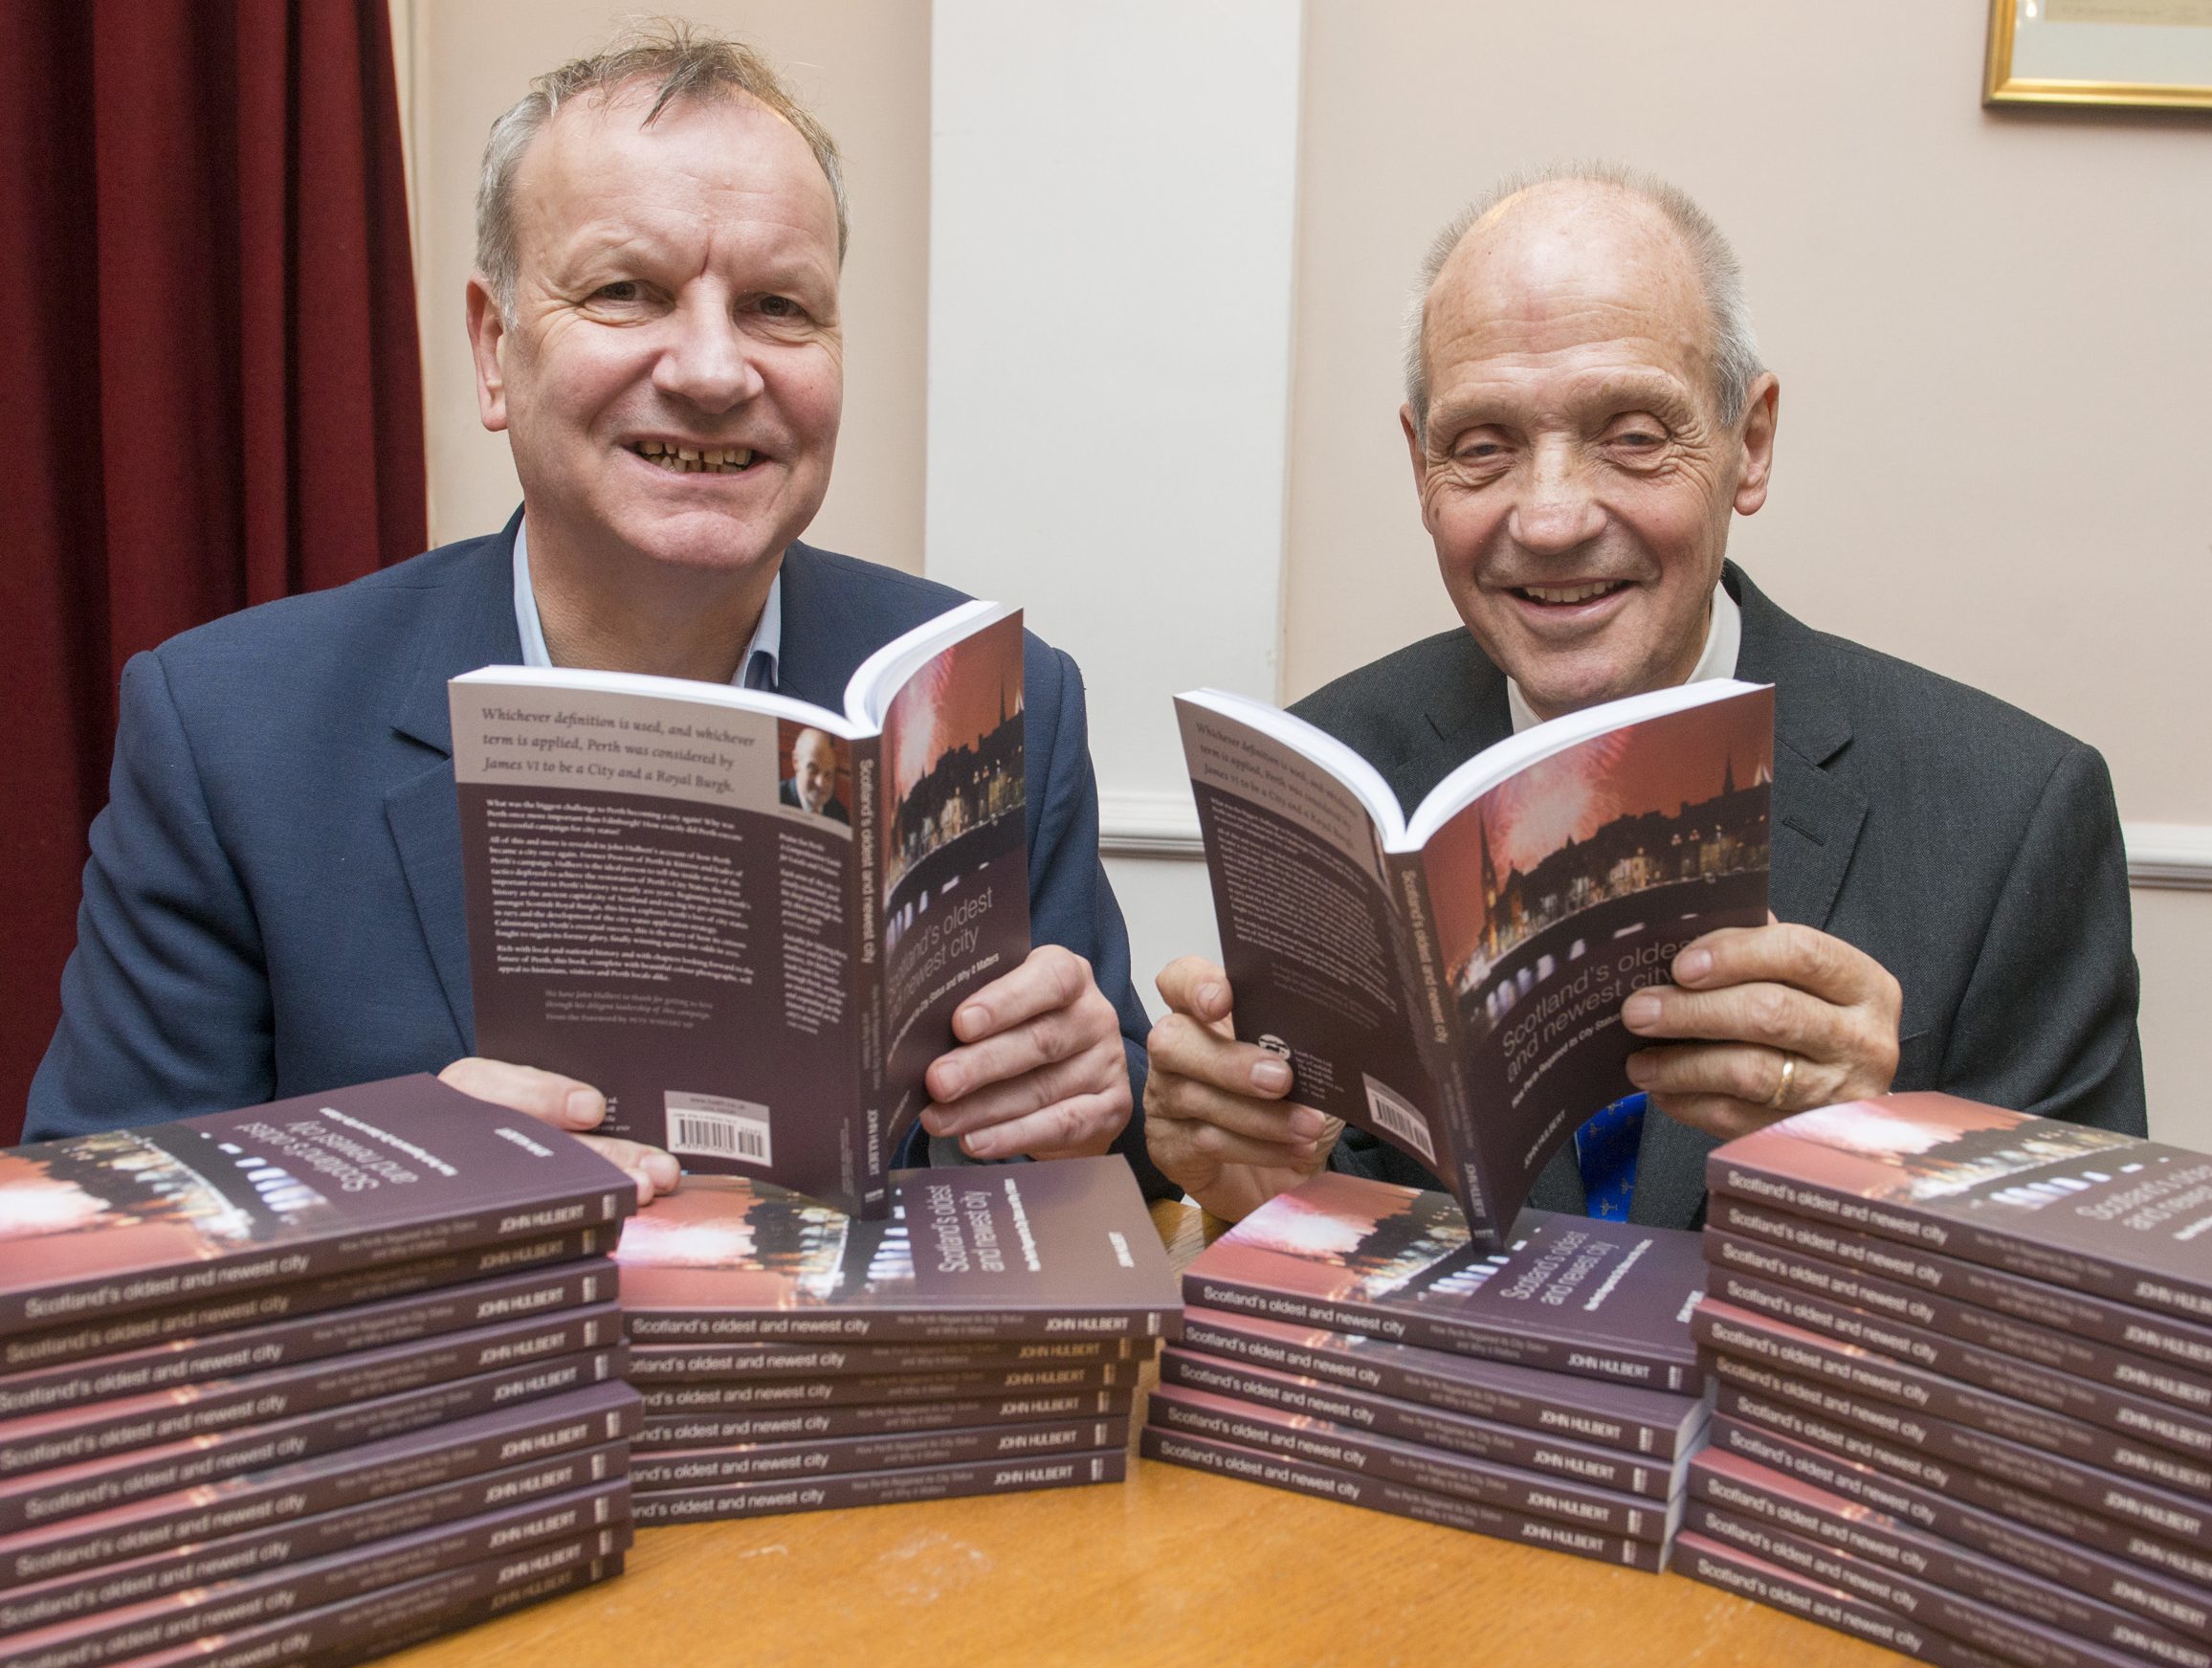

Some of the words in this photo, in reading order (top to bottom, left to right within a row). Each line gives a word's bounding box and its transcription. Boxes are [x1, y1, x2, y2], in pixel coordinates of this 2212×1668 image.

[860, 759, 874, 827] Scotland's
[861, 829, 874, 868] oldest
[862, 870, 874, 895] and
[862, 896, 874, 942] newest
[943, 886, 993, 935] oldest
[861, 942, 876, 964] city
[950, 925, 980, 957] city
[1503, 965, 1610, 1056] Scotland's
[1508, 1032, 1538, 1083] and
[1543, 979, 1624, 1043] newest
[926, 1185, 957, 1215] oldest
[960, 1190, 993, 1210] city
[1729, 1169, 1796, 1202] Scotland's
[1797, 1191, 1839, 1213] oldest
[1841, 1204, 1869, 1222] and
[1870, 1211, 1920, 1235] newest
[1921, 1225, 1948, 1245] city
[499, 1214, 532, 1234] JOHN
[531, 1204, 584, 1226] HULBERT
[963, 1210, 999, 1248] newest
[931, 1215, 970, 1273] Scotland's
[970, 1248, 1005, 1273] and
[26, 1286, 121, 1318] Scotland's
[122, 1276, 178, 1301] oldest
[181, 1269, 216, 1290] and
[217, 1259, 277, 1282] newest
[279, 1255, 309, 1273] city
[633, 1318, 709, 1334] Scotland's
[712, 1319, 757, 1333] oldest
[760, 1319, 788, 1332] and
[791, 1320, 841, 1333] newest
[844, 1319, 870, 1334] city
[1046, 1319, 1076, 1331] JOHN
[1077, 1317, 1128, 1330] HULBERT
[1205, 1285, 1267, 1310] Scotland's
[1269, 1299, 1307, 1317] oldest
[1309, 1307, 1334, 1323] and
[1336, 1312, 1380, 1330] newest
[1382, 1320, 1405, 1337] city
[688, 1356, 733, 1370] oldest
[736, 1354, 764, 1369] and
[766, 1353, 817, 1368] newest
[820, 1352, 845, 1368] city
[1020, 1346, 1049, 1358] JOHN
[1051, 1343, 1099, 1357] HULBERT
[1187, 1326, 1247, 1354] Scotland's
[1249, 1343, 1285, 1362] oldest
[1287, 1352, 1312, 1368] and
[1313, 1358, 1357, 1379] newest
[1359, 1368, 1381, 1387] city
[1569, 1353, 1598, 1369] JOHN
[1599, 1359, 1649, 1378] HULBERT
[494, 1381, 525, 1401] JOHN
[525, 1367, 577, 1392] HULBERT
[999, 1434, 1027, 1450] JOHN
[1029, 1430, 1076, 1447] HULBERT
[1540, 1410, 1569, 1428] JOHN
[1570, 1416, 1621, 1439] HULBERT
[25, 1481, 122, 1519] Scotland's
[122, 1466, 178, 1494] oldest
[180, 1457, 216, 1480] and
[216, 1442, 275, 1469] newest
[276, 1435, 306, 1456] city
[675, 1462, 718, 1479] oldest
[722, 1459, 749, 1475] and
[752, 1455, 801, 1471] newest
[805, 1453, 829, 1469] city
[1161, 1441, 1223, 1468] Scotland's
[1225, 1457, 1262, 1476] oldest
[1265, 1466, 1289, 1482] and
[1292, 1472, 1335, 1492] newest
[1338, 1482, 1360, 1500] city
[1731, 1430, 1793, 1468] Scotland's
[1795, 1458, 1834, 1483] oldest
[1835, 1474, 1862, 1494] and
[1863, 1484, 1910, 1512] newest
[1911, 1503, 1936, 1525] city
[1522, 1523, 1552, 1541] JOHN
[1553, 1530, 1604, 1551] HULBERT
[1698, 1558, 1766, 1596] Scotland's
[1769, 1586, 1811, 1612] oldest
[1813, 1602, 1842, 1622] and
[1843, 1612, 1893, 1640] newest
[1895, 1631, 1921, 1653] city
[2112, 1581, 2145, 1605] JOHN
[2147, 1594, 2205, 1627] HULBERT
